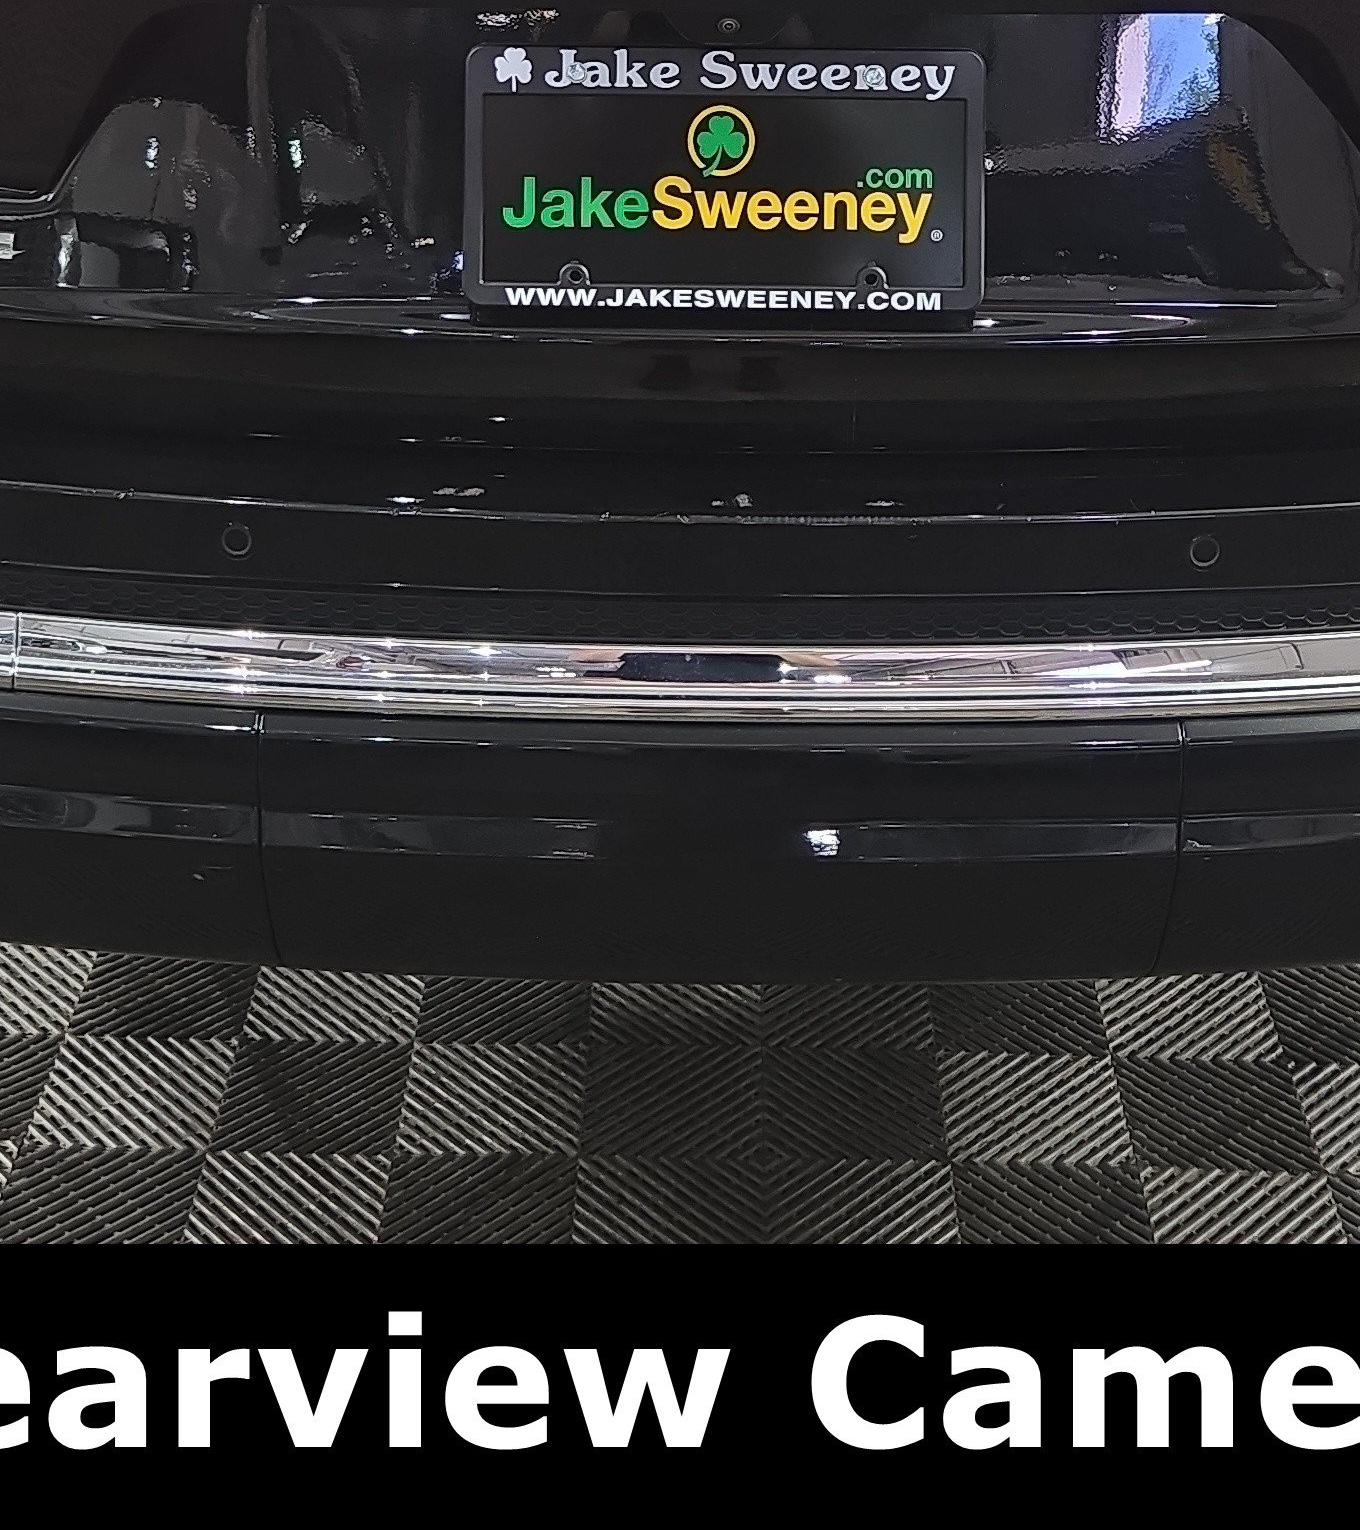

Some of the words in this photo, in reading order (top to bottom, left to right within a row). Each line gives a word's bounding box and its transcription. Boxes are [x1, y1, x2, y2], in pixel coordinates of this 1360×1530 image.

[544, 49, 681, 89] Jake
[699, 51, 956, 100] Sweeney
[502, 175, 933, 244] JakeSweeney
[505, 287, 942, 311] WWW.JAKESWEENEY.COM
